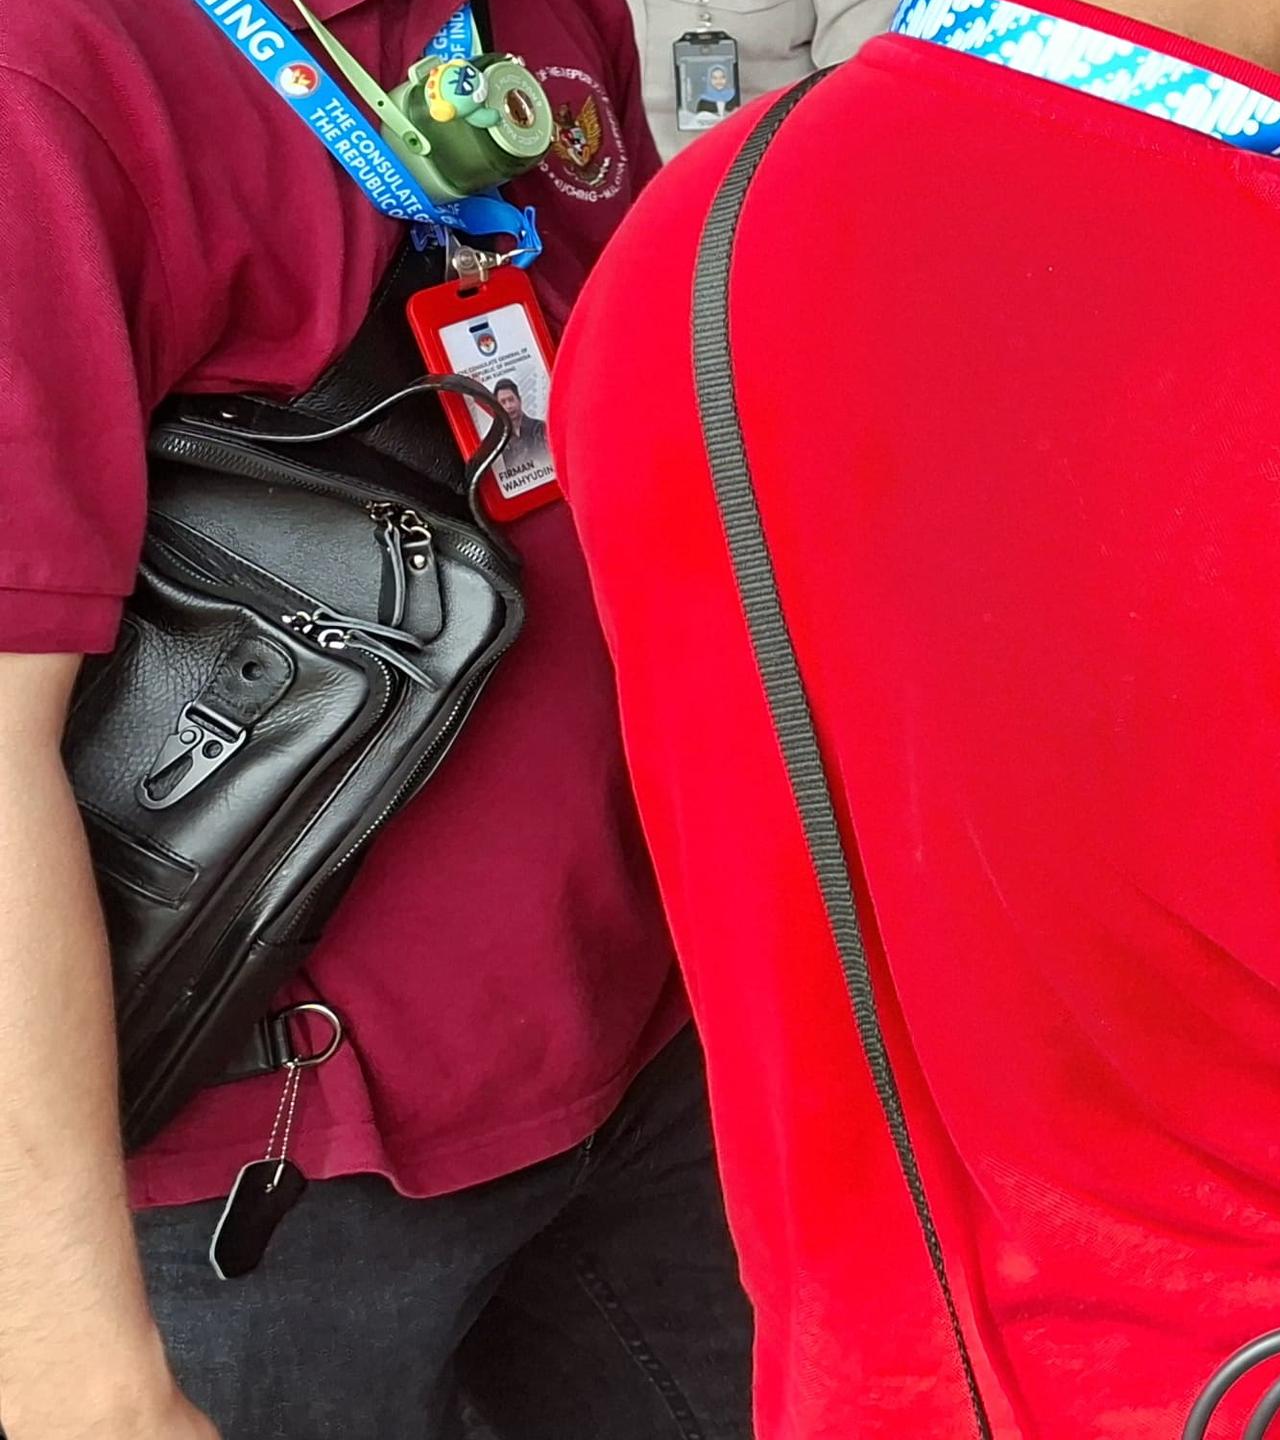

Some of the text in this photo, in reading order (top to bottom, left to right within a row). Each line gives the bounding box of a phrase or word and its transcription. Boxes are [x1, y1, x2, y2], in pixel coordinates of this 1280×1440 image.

[309, 107, 397, 210] THE REPUBLIC
[325, 97, 426, 215] THE CONSULATE
